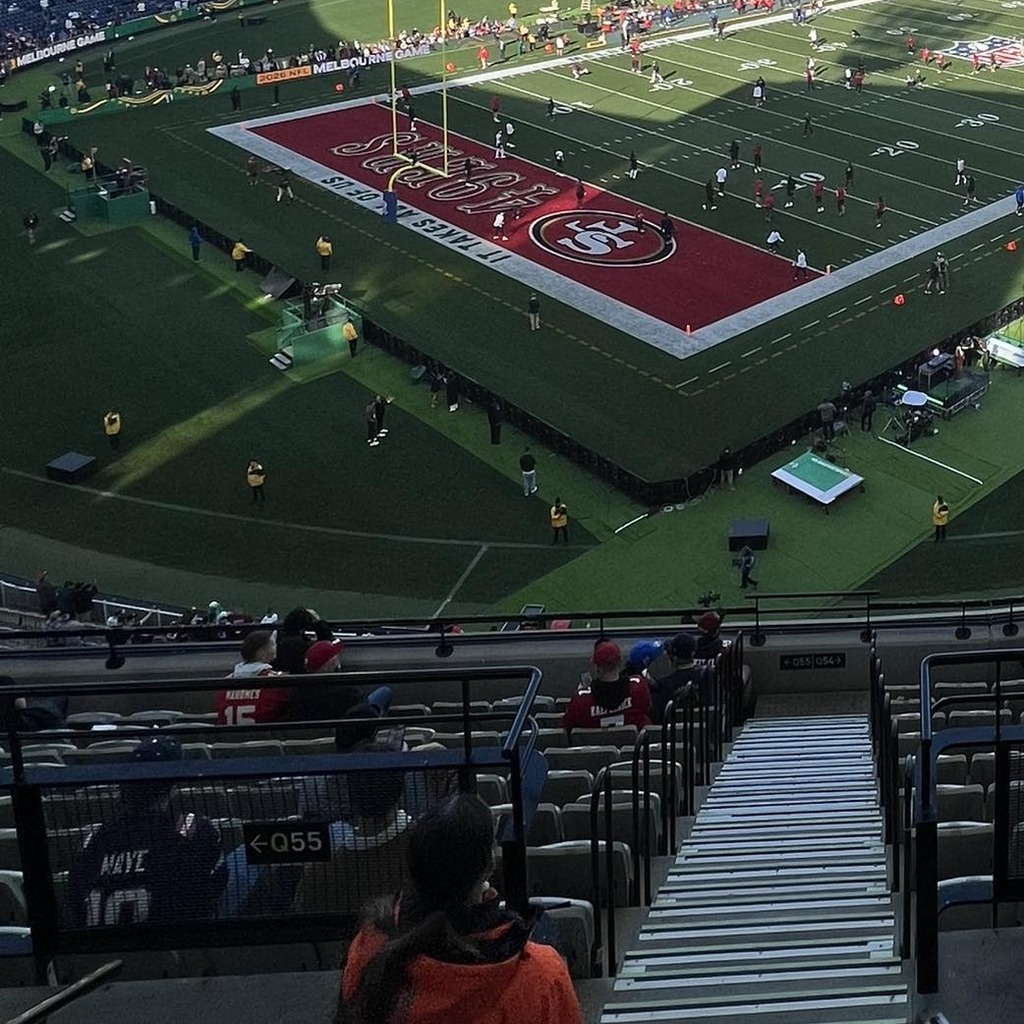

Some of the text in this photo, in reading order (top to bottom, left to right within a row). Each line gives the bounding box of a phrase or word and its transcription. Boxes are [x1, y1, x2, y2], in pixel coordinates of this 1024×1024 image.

[16, 39, 77, 67] MELBOURNE
[77, 31, 106, 47] GAME
[259, 70, 286, 82] 2026
[313, 51, 393, 75] MELBOURNE
[395, 44, 431, 60] GAME
[320, 176, 355, 190] US
[346, 190, 380, 201] OF
[411, 219, 482, 251] TAKES
[476, 250, 512, 263] IT
[224, 705, 257, 726] 15
[270, 832, 322, 853] Q55
